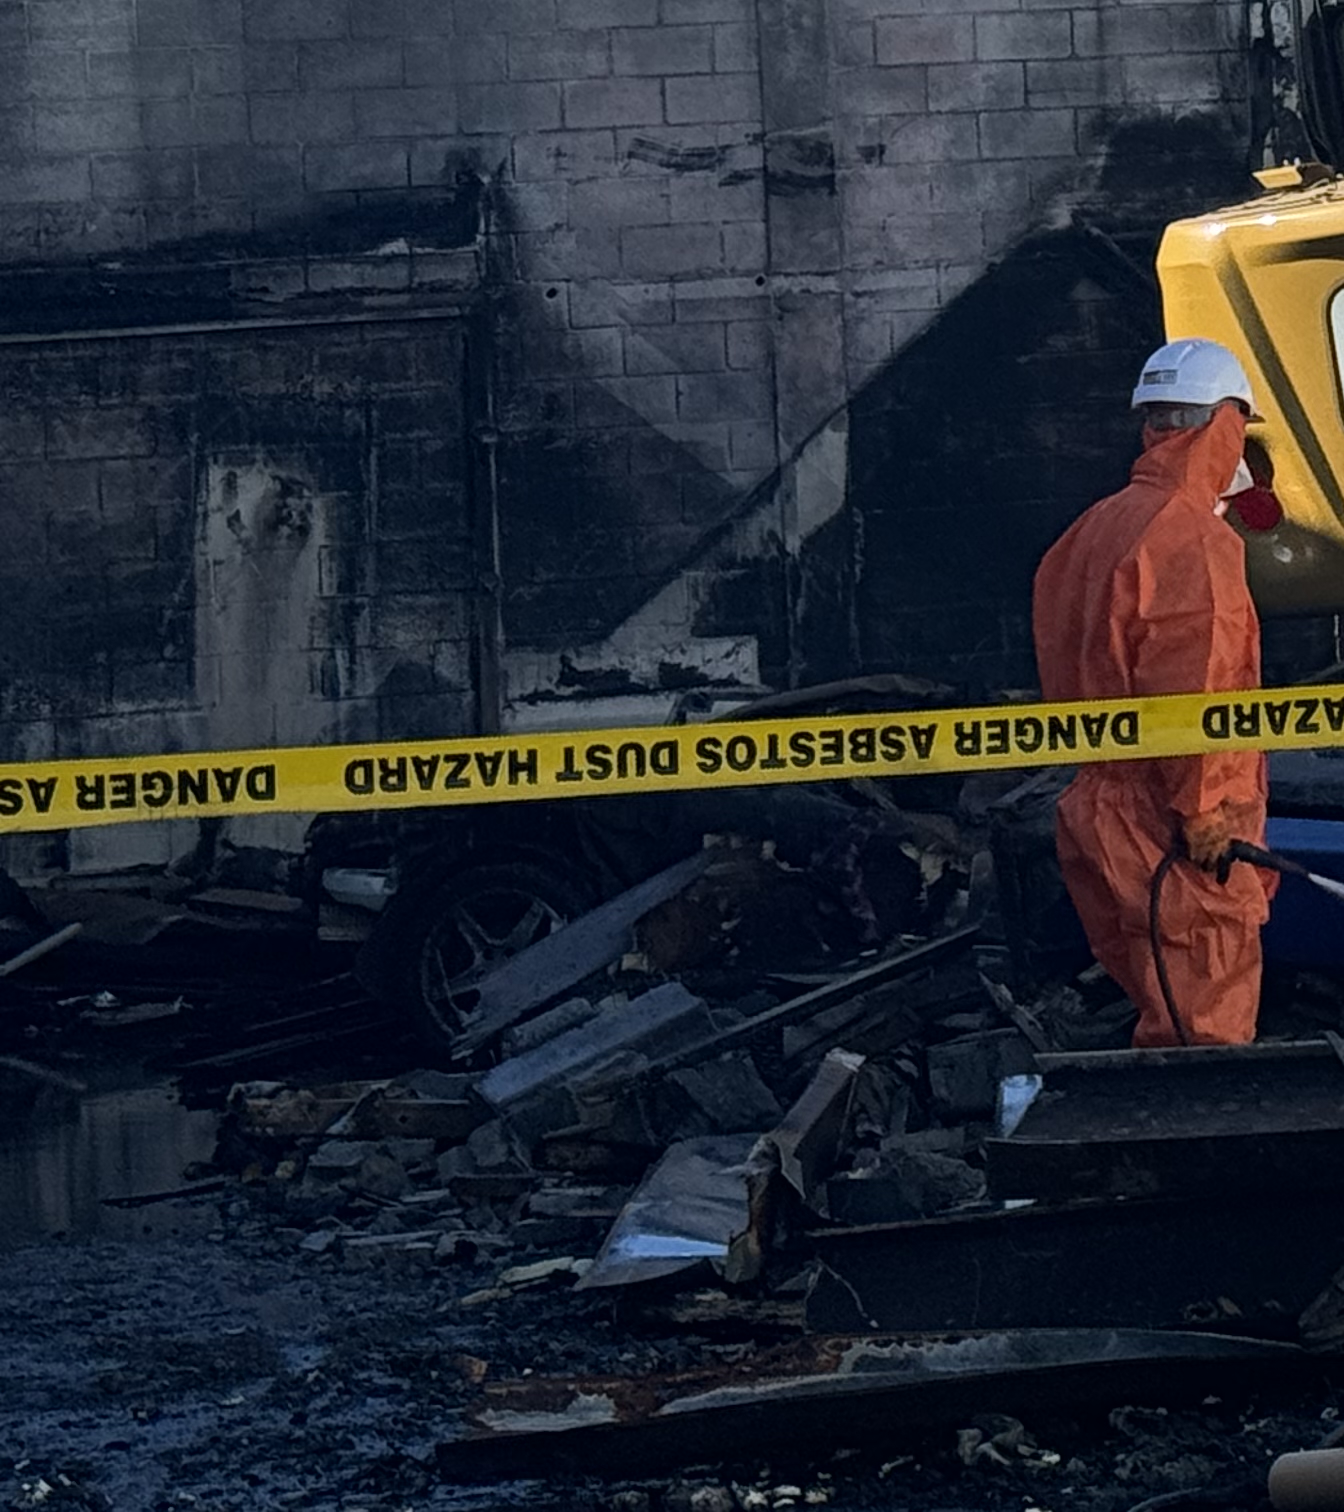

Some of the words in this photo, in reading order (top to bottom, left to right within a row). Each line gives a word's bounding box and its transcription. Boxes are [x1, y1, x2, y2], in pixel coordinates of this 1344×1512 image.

[696, 723, 936, 773] ASBESTOS
[954, 711, 1138, 756] DANGER
[345, 749, 537, 795] HAZARD
[556, 740, 679, 782] DUST
[75, 764, 275, 810] DANGER
